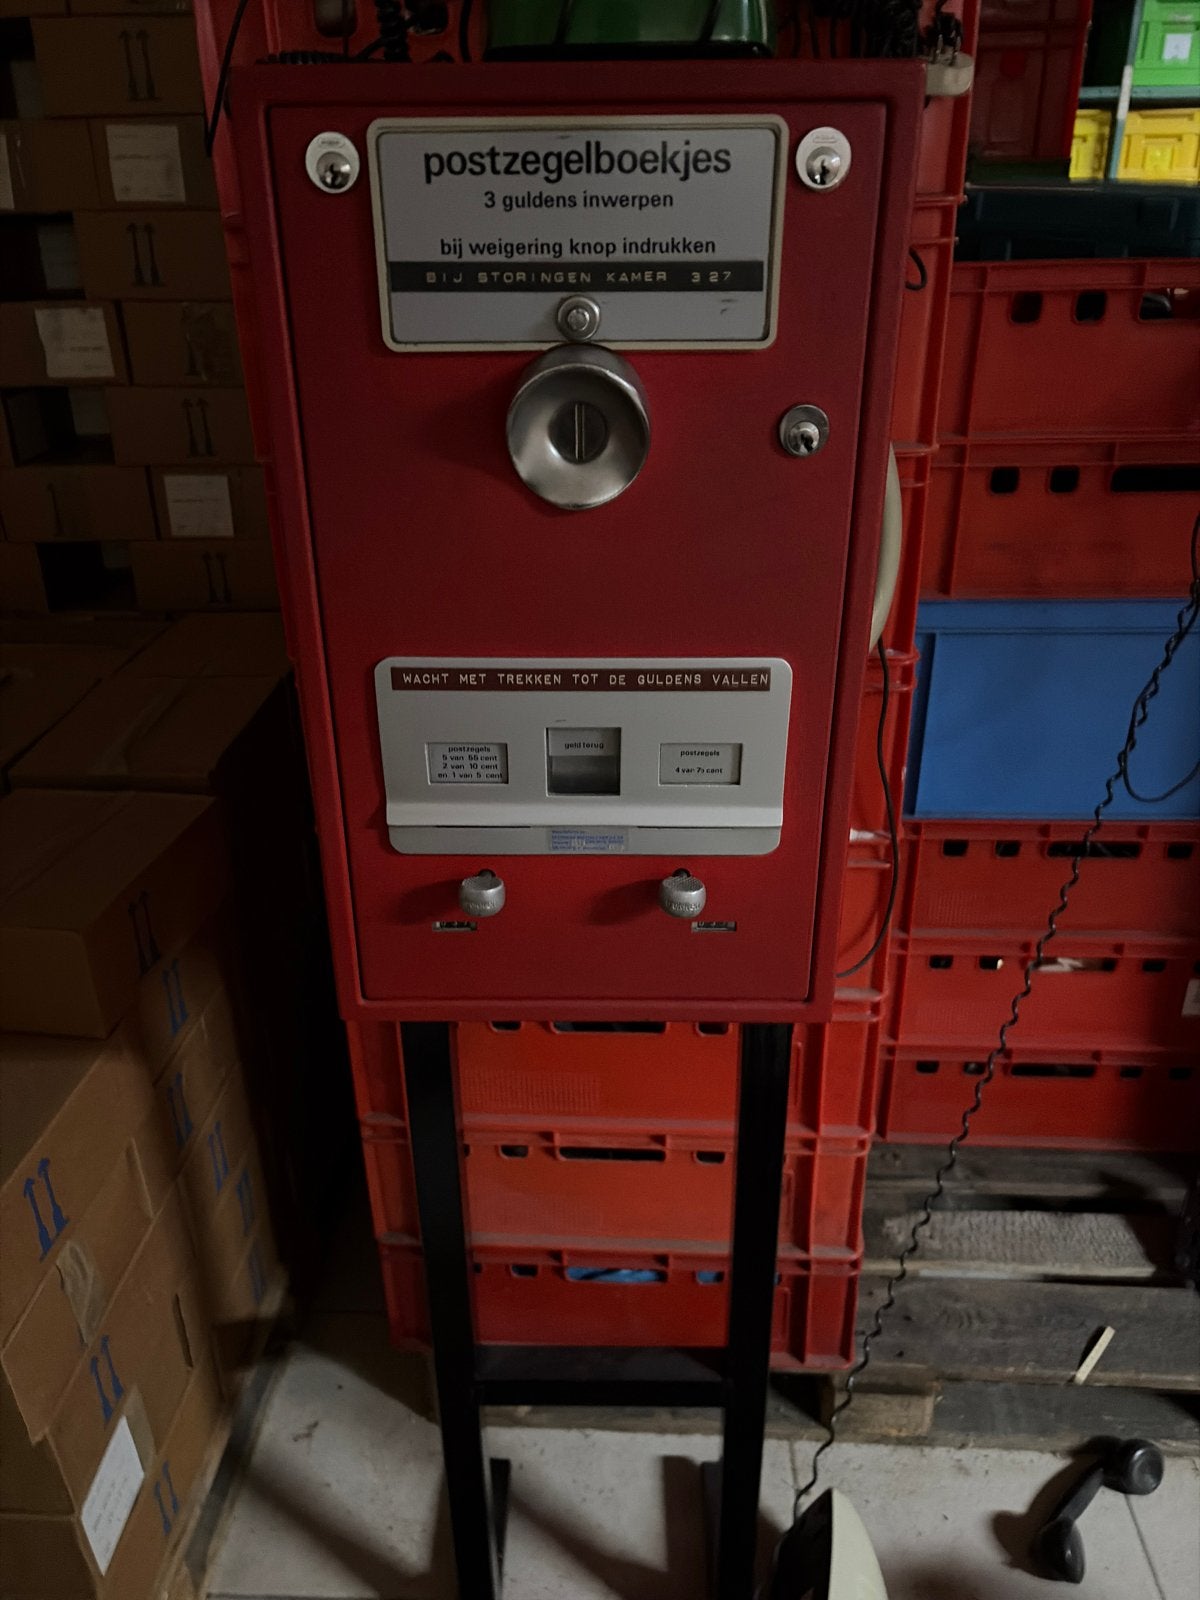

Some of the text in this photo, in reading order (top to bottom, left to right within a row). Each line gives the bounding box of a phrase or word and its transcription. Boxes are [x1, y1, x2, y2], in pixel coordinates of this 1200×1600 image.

[424, 140, 731, 184] postzegelboekjes
[484, 191, 674, 212] 3 guldens inwerpen
[440, 237, 716, 258] bij weigering knop indrukken
[424, 273, 463, 283] BIJ
[477, 271, 592, 283] STORINGEN
[606, 271, 667, 283] KAMER
[402, 673, 769, 686] WACHT MET TREKKEN TOT DE GULDENS VALLEN
